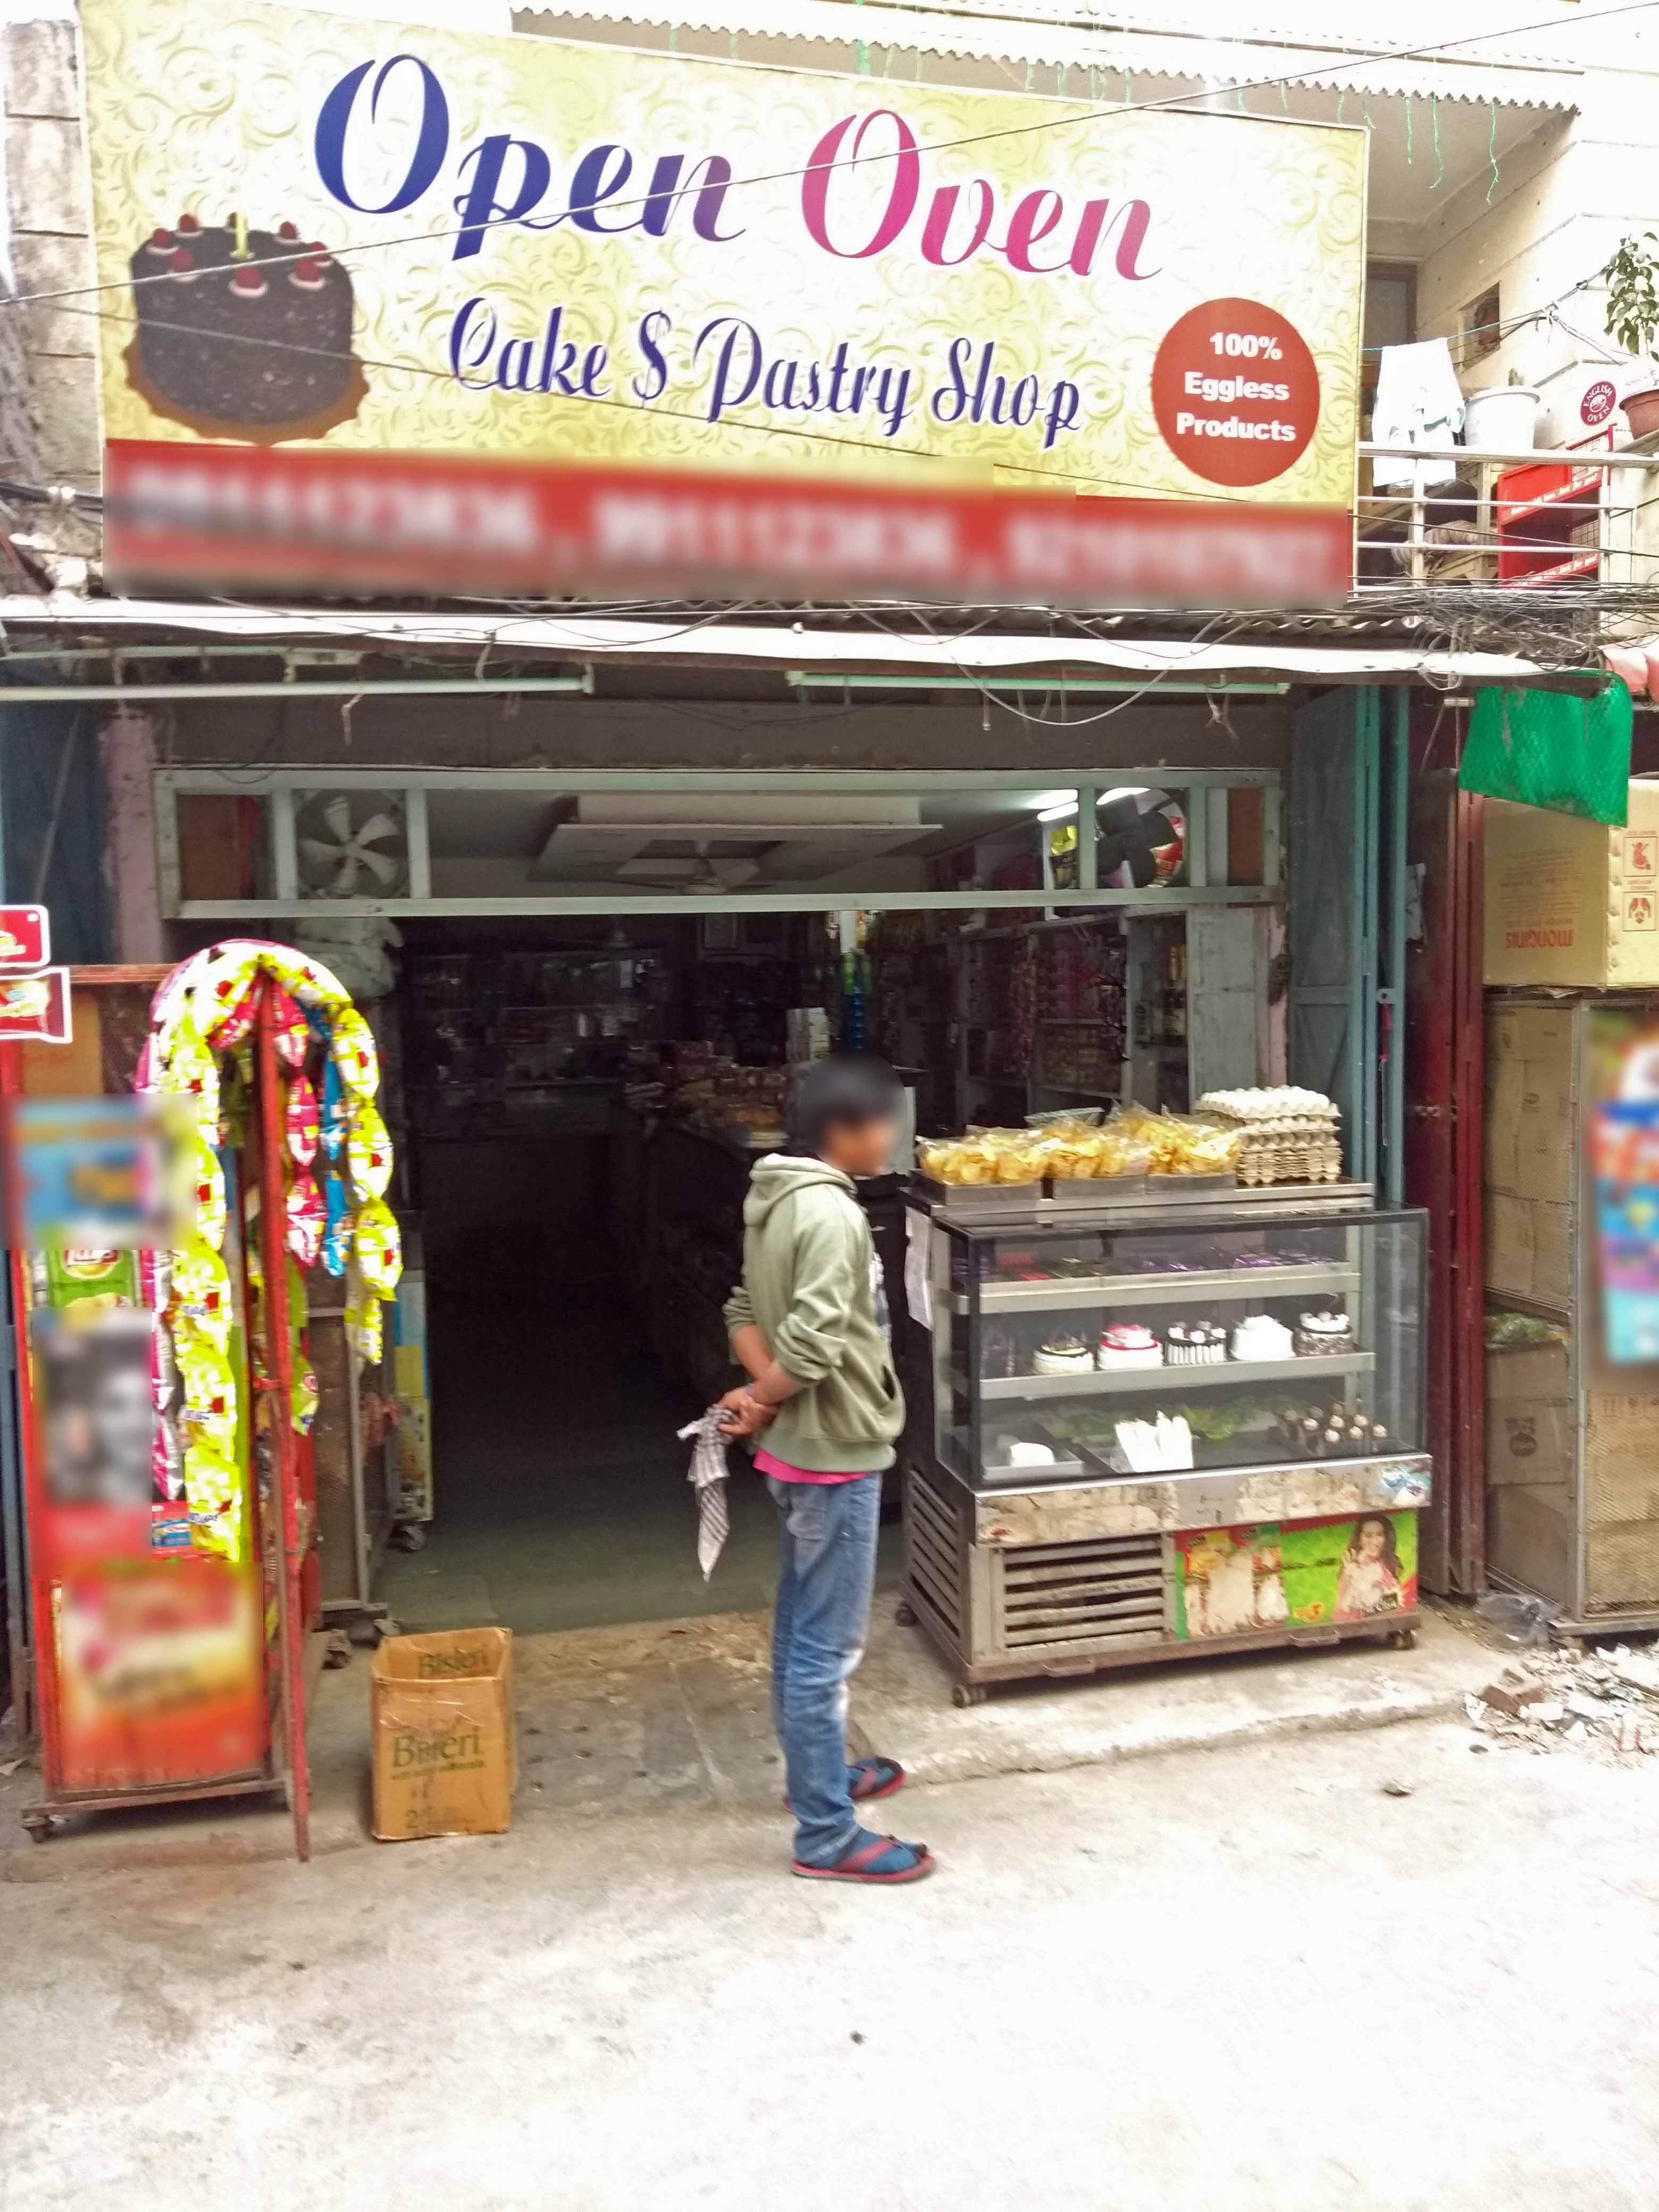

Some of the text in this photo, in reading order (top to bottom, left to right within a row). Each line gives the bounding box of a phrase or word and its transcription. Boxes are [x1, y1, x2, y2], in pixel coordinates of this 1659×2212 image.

[315, 54, 1162, 280] Open Oven
[1210, 332, 1283, 361] 100%
[450, 297, 611, 395] Cake
[693, 317, 915, 437] Pastry
[931, 337, 1082, 449] Shop
[1185, 371, 1289, 403] Eggless
[1582, 384, 1613, 406] ENGLISH
[1177, 412, 1296, 441] Products
[1587, 405, 1610, 422] OVEN
